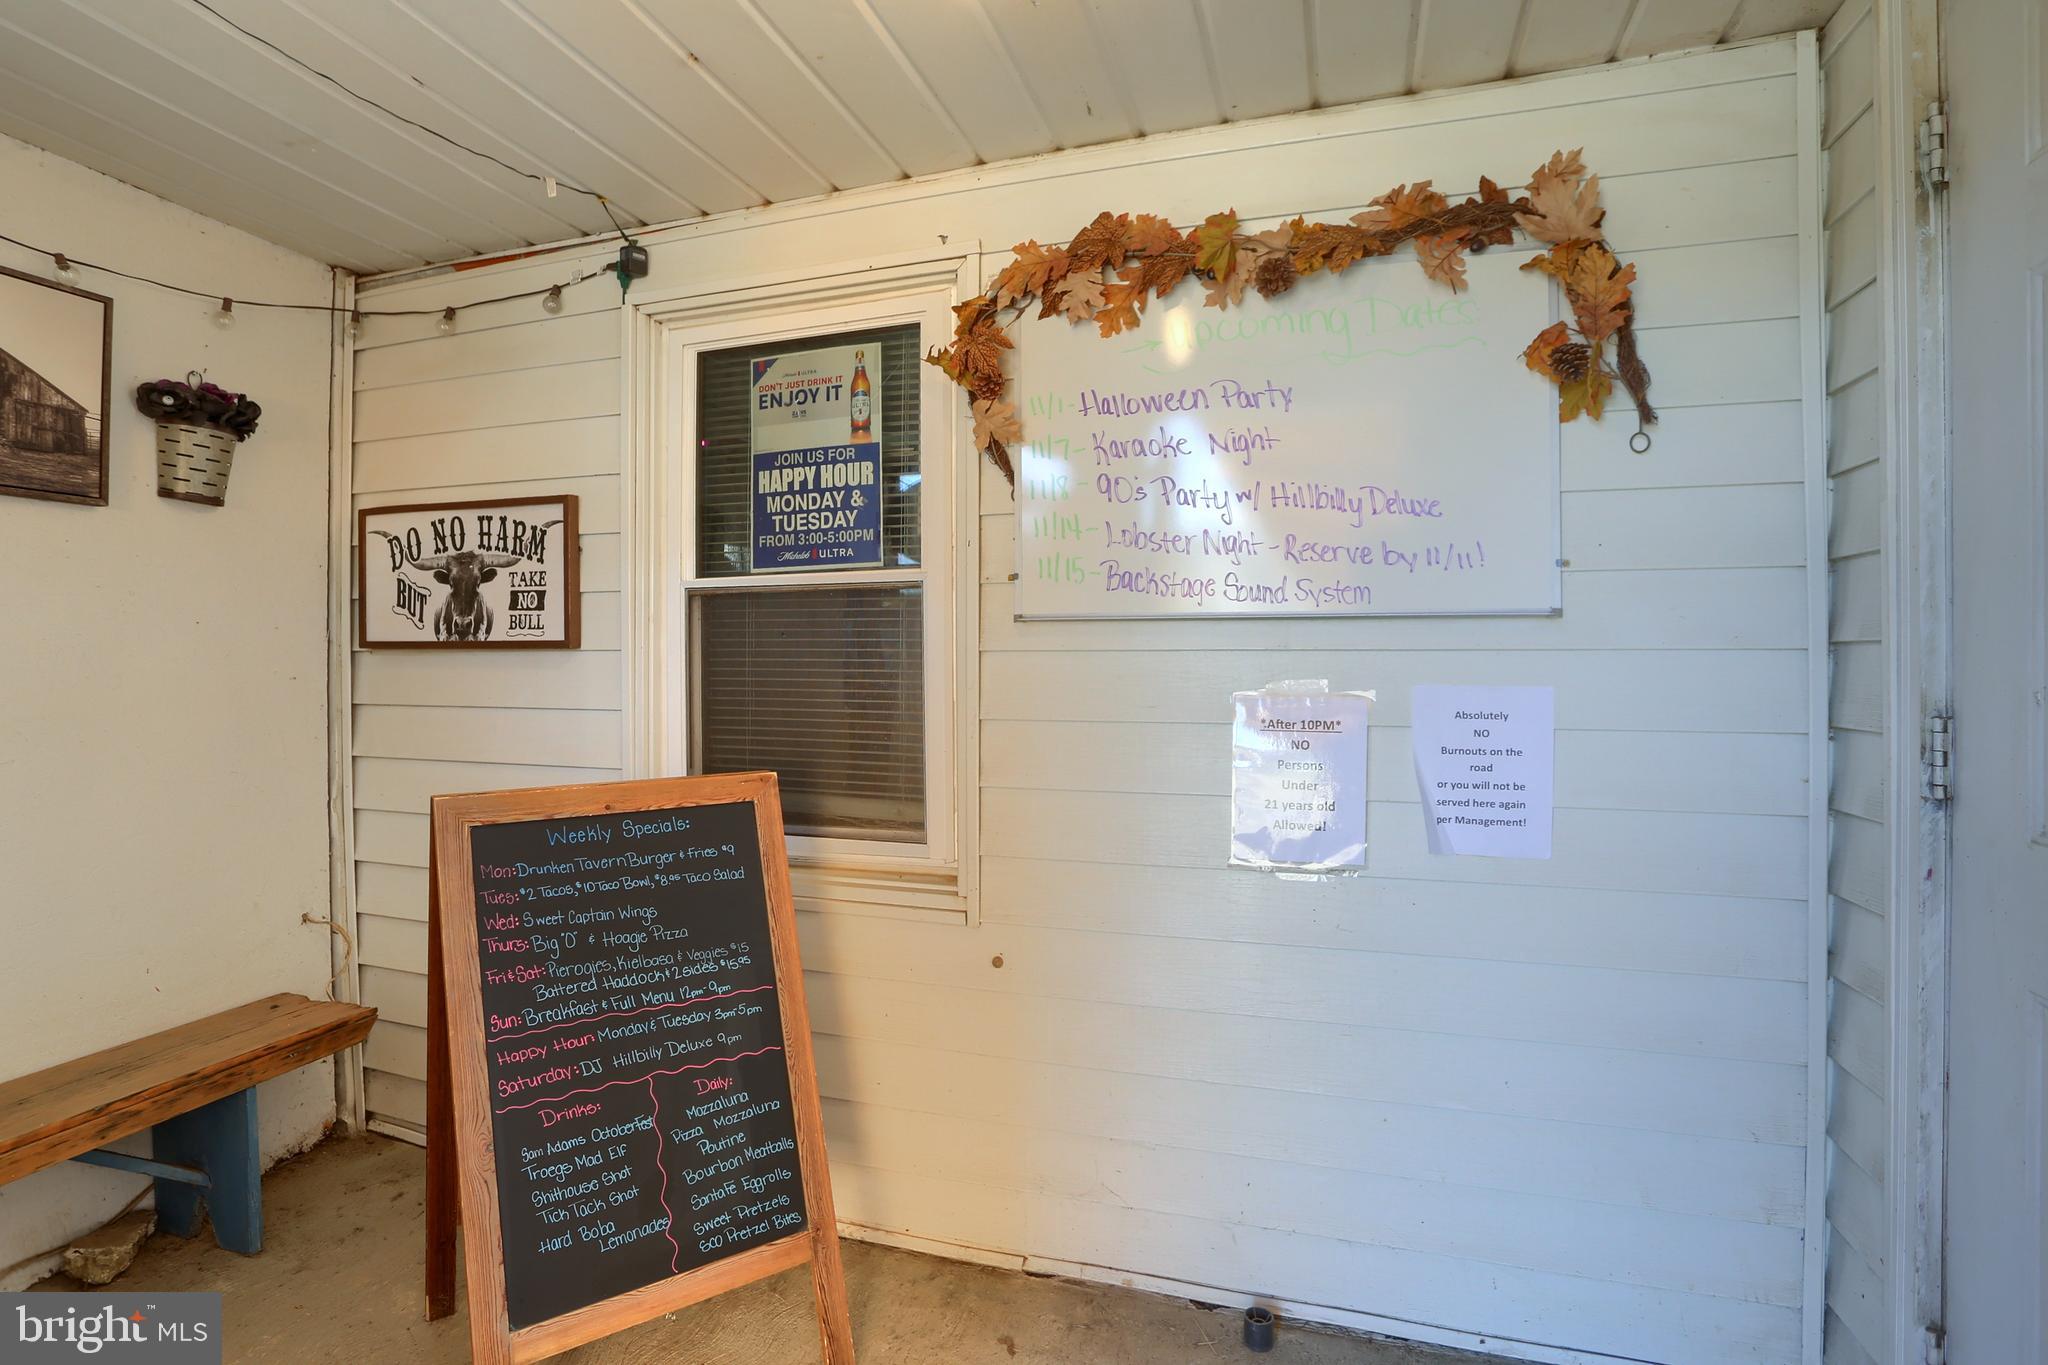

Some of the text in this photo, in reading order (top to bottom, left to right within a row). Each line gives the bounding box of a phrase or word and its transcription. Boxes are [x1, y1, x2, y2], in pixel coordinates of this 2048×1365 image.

[759, 376, 843, 392] DON'T JUST DRINK IT
[759, 385, 842, 410] ENJOY IT
[1079, 388, 1210, 417] Halloween
[1210, 379, 1292, 412] Party
[775, 448, 855, 467] JOIN US FOR
[1092, 427, 1192, 465] Karaoke
[1209, 427, 1280, 465] Night
[759, 461, 874, 494] HAPPY HOUR
[767, 490, 864, 513] MONDAY &
[1097, 473, 1147, 503] 90's
[1151, 476, 1231, 524] Party
[1271, 482, 1363, 527] Hillbilly
[1361, 485, 1443, 518] Deluxe
[772, 510, 858, 533] TUESDAY
[387, 515, 547, 572] DO NO HARM
[759, 529, 874, 548] FROM 3:00-5:00PM
[1106, 520, 1196, 554] Lobster
[1203, 522, 1265, 564] Night
[1284, 537, 1373, 564] Reserve
[1383, 541, 1419, 572] by
[819, 548, 854, 558] ULTRA
[509, 571, 546, 587] TAKE
[1101, 560, 1216, 606] Backstage
[1224, 574, 1288, 603] Sound
[1295, 578, 1371, 605] System
[397, 578, 427, 623] BUT
[517, 593, 538, 609] NO
[509, 615, 544, 630] BULL
[1455, 710, 1509, 722] Absolutely
[1291, 740, 1310, 750] NO
[1473, 729, 1490, 738] NO
[1277, 760, 1323, 771] Persons
[1441, 747, 1487, 756] Burnouts
[1505, 748, 1523, 756] the
[1470, 764, 1493, 772] road
[1282, 780, 1318, 791] Under
[1451, 782, 1468, 792] you
[1472, 781, 1490, 790] will
[1513, 782, 1525, 791] be
[1264, 800, 1335, 813] 21 years old
[1436, 799, 1526, 811] served here again
[546, 816, 690, 846] Weekly Specials:
[1273, 820, 1326, 832] Allowed!
[1437, 816, 1526, 829] per Management!
[480, 845, 718, 879] Mon: Drunken Tavern Burger Fries
[480, 890, 519, 904] Tues:
[519, 887, 536, 900] $2
[539, 884, 578, 898] Tacos,
[598, 880, 620, 892] Taco
[621, 875, 655, 891] Bowl,
[683, 873, 711, 884] Taco
[713, 866, 745, 881] Salad
[484, 905, 658, 930] Wed: Sweet Captain Wings
[482, 937, 530, 953] Thurs:
[530, 934, 560, 959] Big
[602, 929, 648, 952] Hoagie
[651, 925, 689, 940] Pizza
[546, 943, 750, 977] Pierogies, Kielbasa Veggies $15
[532, 977, 597, 1002] Battered
[602, 970, 665, 990] Haddock
[491, 1015, 522, 1032] Sun:
[522, 1001, 599, 1027] Breakfast
[610, 994, 636, 1011] Full
[642, 990, 675, 1006] Menu
[497, 1047, 547, 1066] Happy
[554, 1034, 595, 1050] Hour:
[597, 1022, 649, 1043] Monday
[657, 1012, 712, 1030] Tuesday
[498, 1033, 742, 1097] Saturday: DJ Hillbilly Deluxe 9pm
[693, 1076, 733, 1095] Daily:
[538, 1103, 601, 1127] Drinks:
[687, 1091, 750, 1120] Mozzaluna
[670, 1101, 780, 1144] Pizza Mozzaluna
[521, 1148, 543, 1163] Sam
[546, 1135, 586, 1154] Adams
[697, 1132, 746, 1156] Poutine
[522, 1144, 627, 1183] Troegs Mad Elf
[682, 1138, 795, 1185] Bourbon Meatballs
[532, 1166, 632, 1208] Shithouse Shot
[742, 1168, 791, 1195] Eggrolls
[537, 1186, 640, 1225] Tick Tack Shot
[694, 1195, 790, 1235] Sweet Pretzels
[538, 1220, 616, 1253] Hard Boba
[600, 1217, 671, 1252] Lemonades
[725, 1211, 802, 1244] Pretzel Bites
